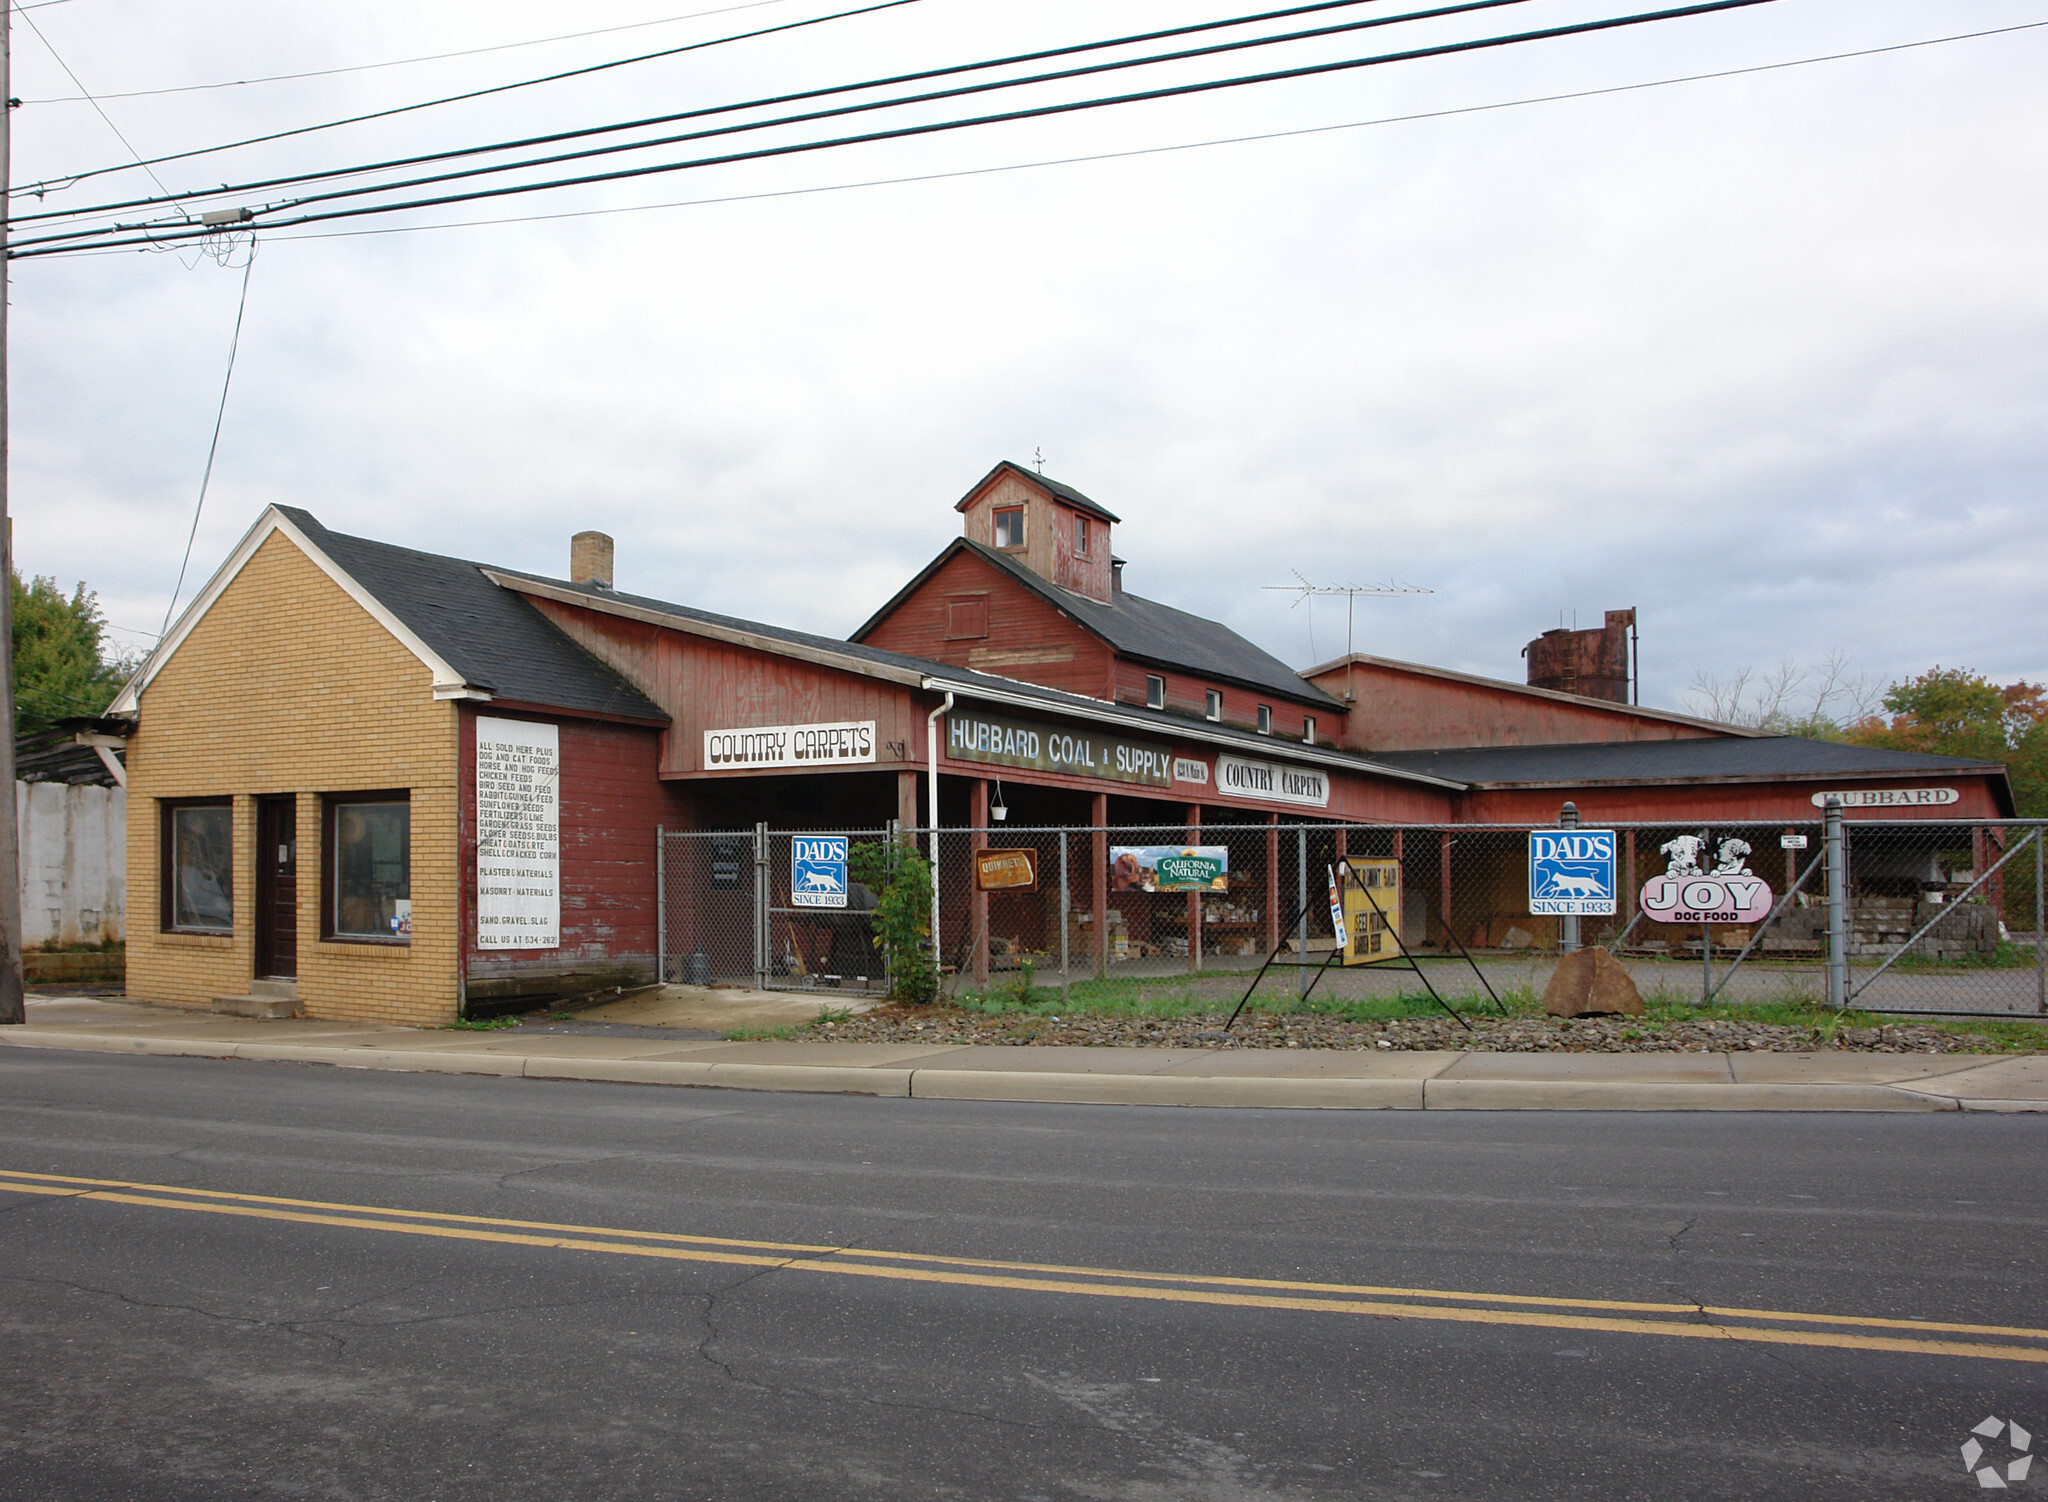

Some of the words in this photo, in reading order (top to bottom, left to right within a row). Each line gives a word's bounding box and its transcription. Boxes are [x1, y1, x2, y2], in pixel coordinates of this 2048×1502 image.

[479, 742, 492, 751] ALL
[496, 743, 513, 753] SOLD
[516, 745, 533, 755] HERE
[536, 747, 553, 757] PLUS
[710, 732, 786, 764] COUNTRY
[794, 727, 871, 760] CARPETS
[951, 718, 1039, 759] HUBBARD
[1049, 733, 1095, 768] COAL
[1116, 745, 1170, 779] SUPPLY
[479, 752, 492, 760] DOG
[496, 753, 509, 762] AND
[513, 755, 526, 764] CAT
[530, 756, 551, 766] FOODS
[479, 762, 501, 771] HORSE
[504, 764, 518, 772] AND
[522, 765, 535, 774] HOG
[479, 772, 508, 781] CHICKEN
[511, 774, 533, 783] FEEDS
[1226, 763, 1274, 792] COUNTRY
[1282, 772, 1322, 799] CARPETS
[479, 781, 495, 790] BIRD
[498, 782, 516, 791] SEED
[519, 784, 532, 793] AND
[535, 785, 552, 794] FEED
[536, 795, 554, 804] FEED
[480, 800, 520, 811] SUNFLOWER
[522, 804, 544, 812] SEEDS
[529, 814, 544, 822] LIME
[480, 829, 506, 838] FLOWER
[536, 824, 557, 832] SEEDS
[795, 841, 844, 860] DAD'S
[1533, 836, 1612, 860] DAD'S
[540, 852, 557, 860] CORN
[1162, 860, 1216, 872] CALIFORNIA
[1170, 868, 1210, 878] NATURAL
[480, 887, 512, 896] MASONRY
[516, 888, 554, 897] MATERIALS
[1645, 881, 1762, 911] JOY
[794, 894, 822, 904] SINCE
[824, 895, 844, 905] 1933
[1533, 902, 1576, 913] SINCE
[1581, 902, 1612, 913] 1933
[1675, 912, 1700, 920] DOG
[1704, 912, 1738, 920] FOOD
[480, 936, 498, 944] CALL
[501, 936, 510, 944] US
[513, 936, 522, 944] AT
